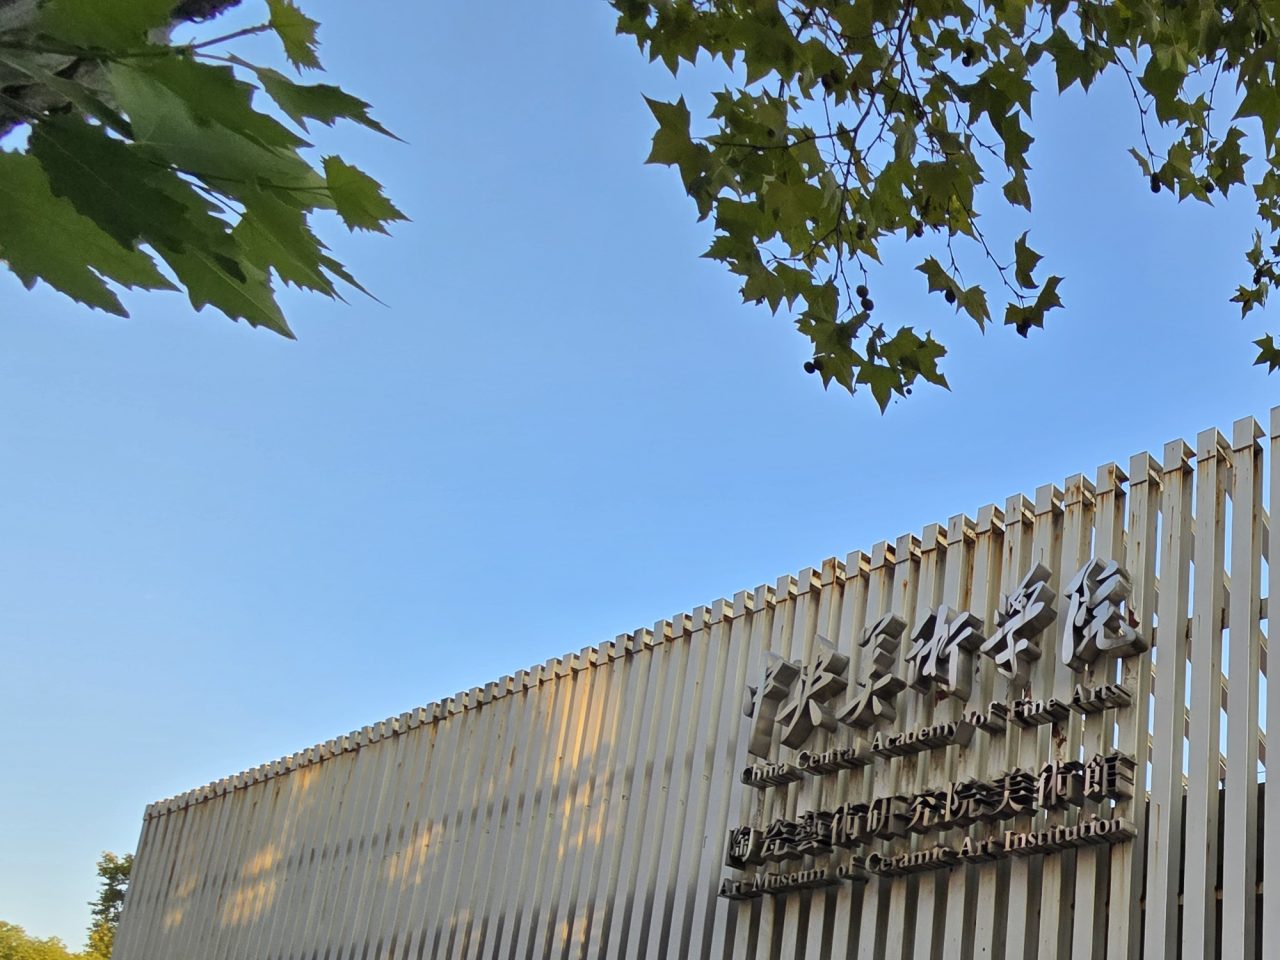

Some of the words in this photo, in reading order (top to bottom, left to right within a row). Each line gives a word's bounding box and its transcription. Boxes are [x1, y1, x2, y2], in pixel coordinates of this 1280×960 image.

[741, 762, 788, 784] China
[796, 738, 866, 770] Central
[871, 711, 969, 751] Academy
[973, 701, 999, 727] of
[1011, 696, 1058, 720] Fine
[1073, 683, 1121, 705] Arts
[719, 878, 746, 897] Art
[751, 865, 828, 892] Museum
[836, 856, 859, 878] of
[865, 845, 952, 873] Ceramic
[958, 835, 996, 858] Art
[1004, 813, 1125, 852] Institution
